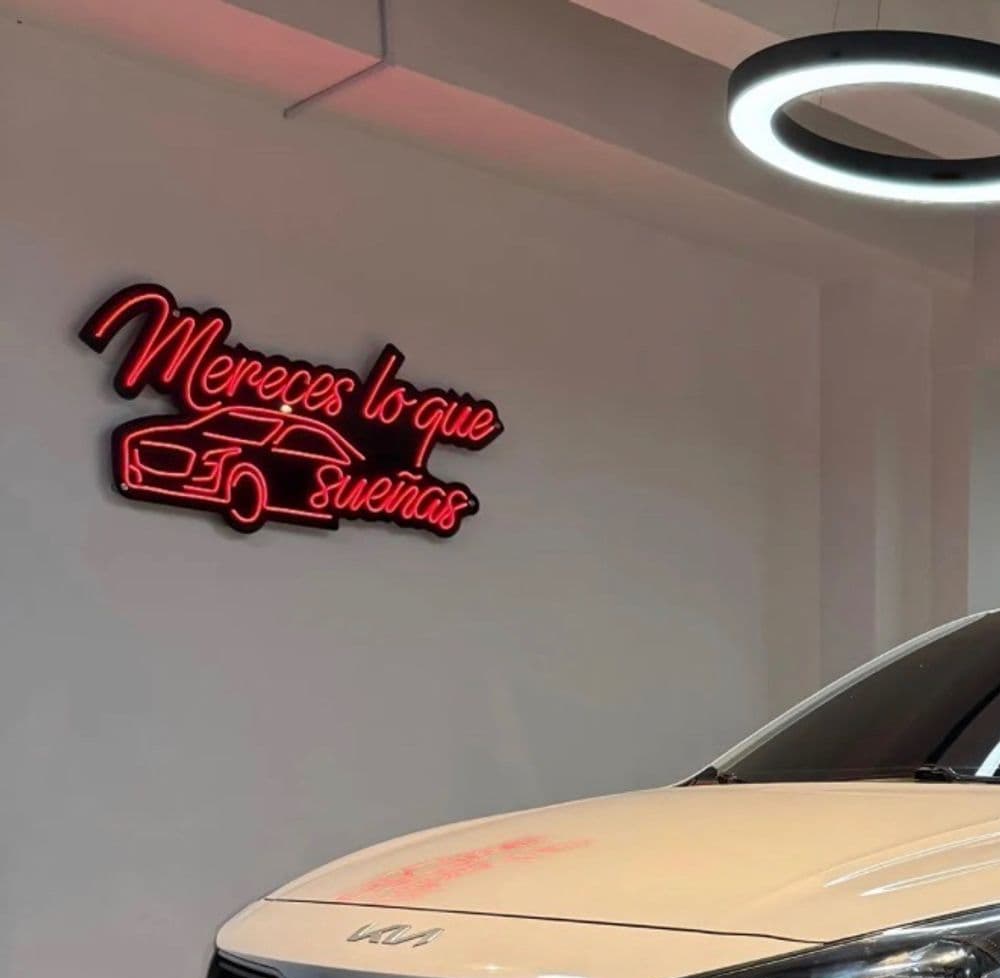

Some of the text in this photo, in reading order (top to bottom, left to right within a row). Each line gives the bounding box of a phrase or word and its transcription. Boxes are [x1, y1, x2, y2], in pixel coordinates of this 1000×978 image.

[94, 292, 497, 468] Mereces lo que
[346, 921, 445, 948] KIA
